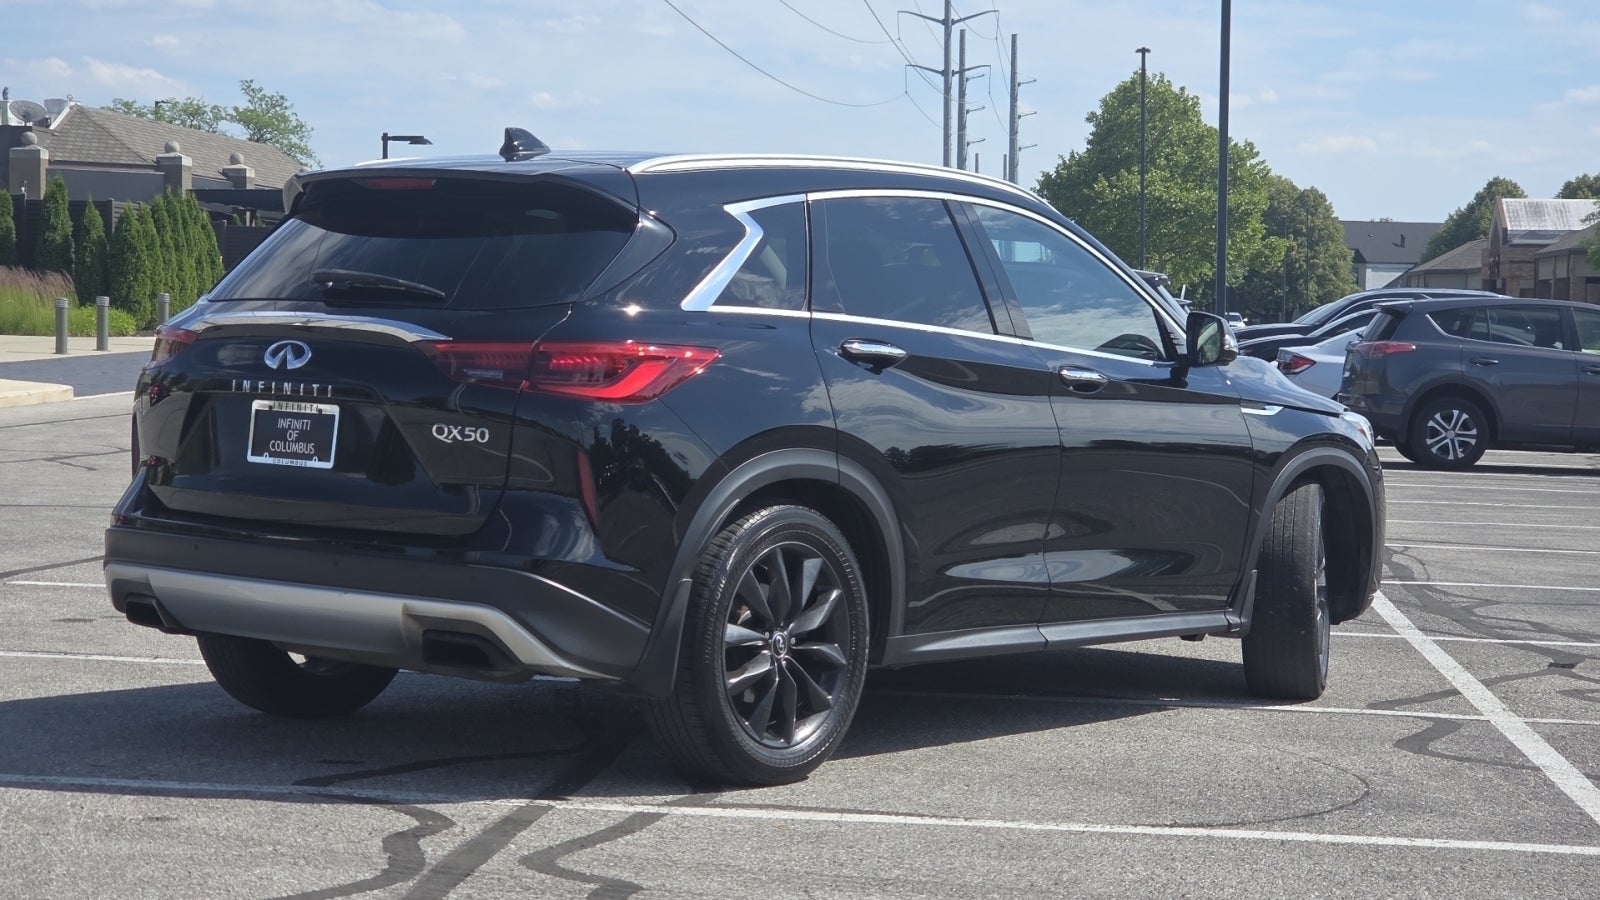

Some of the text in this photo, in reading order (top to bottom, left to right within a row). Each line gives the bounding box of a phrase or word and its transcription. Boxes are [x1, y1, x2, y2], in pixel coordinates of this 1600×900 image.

[232, 379, 332, 398] INFINITI
[273, 401, 319, 412] INFINITI
[277, 418, 311, 430] INFINITI
[286, 430, 299, 441] OF
[431, 423, 490, 443] QX50
[269, 440, 315, 454] COLUMBUS
